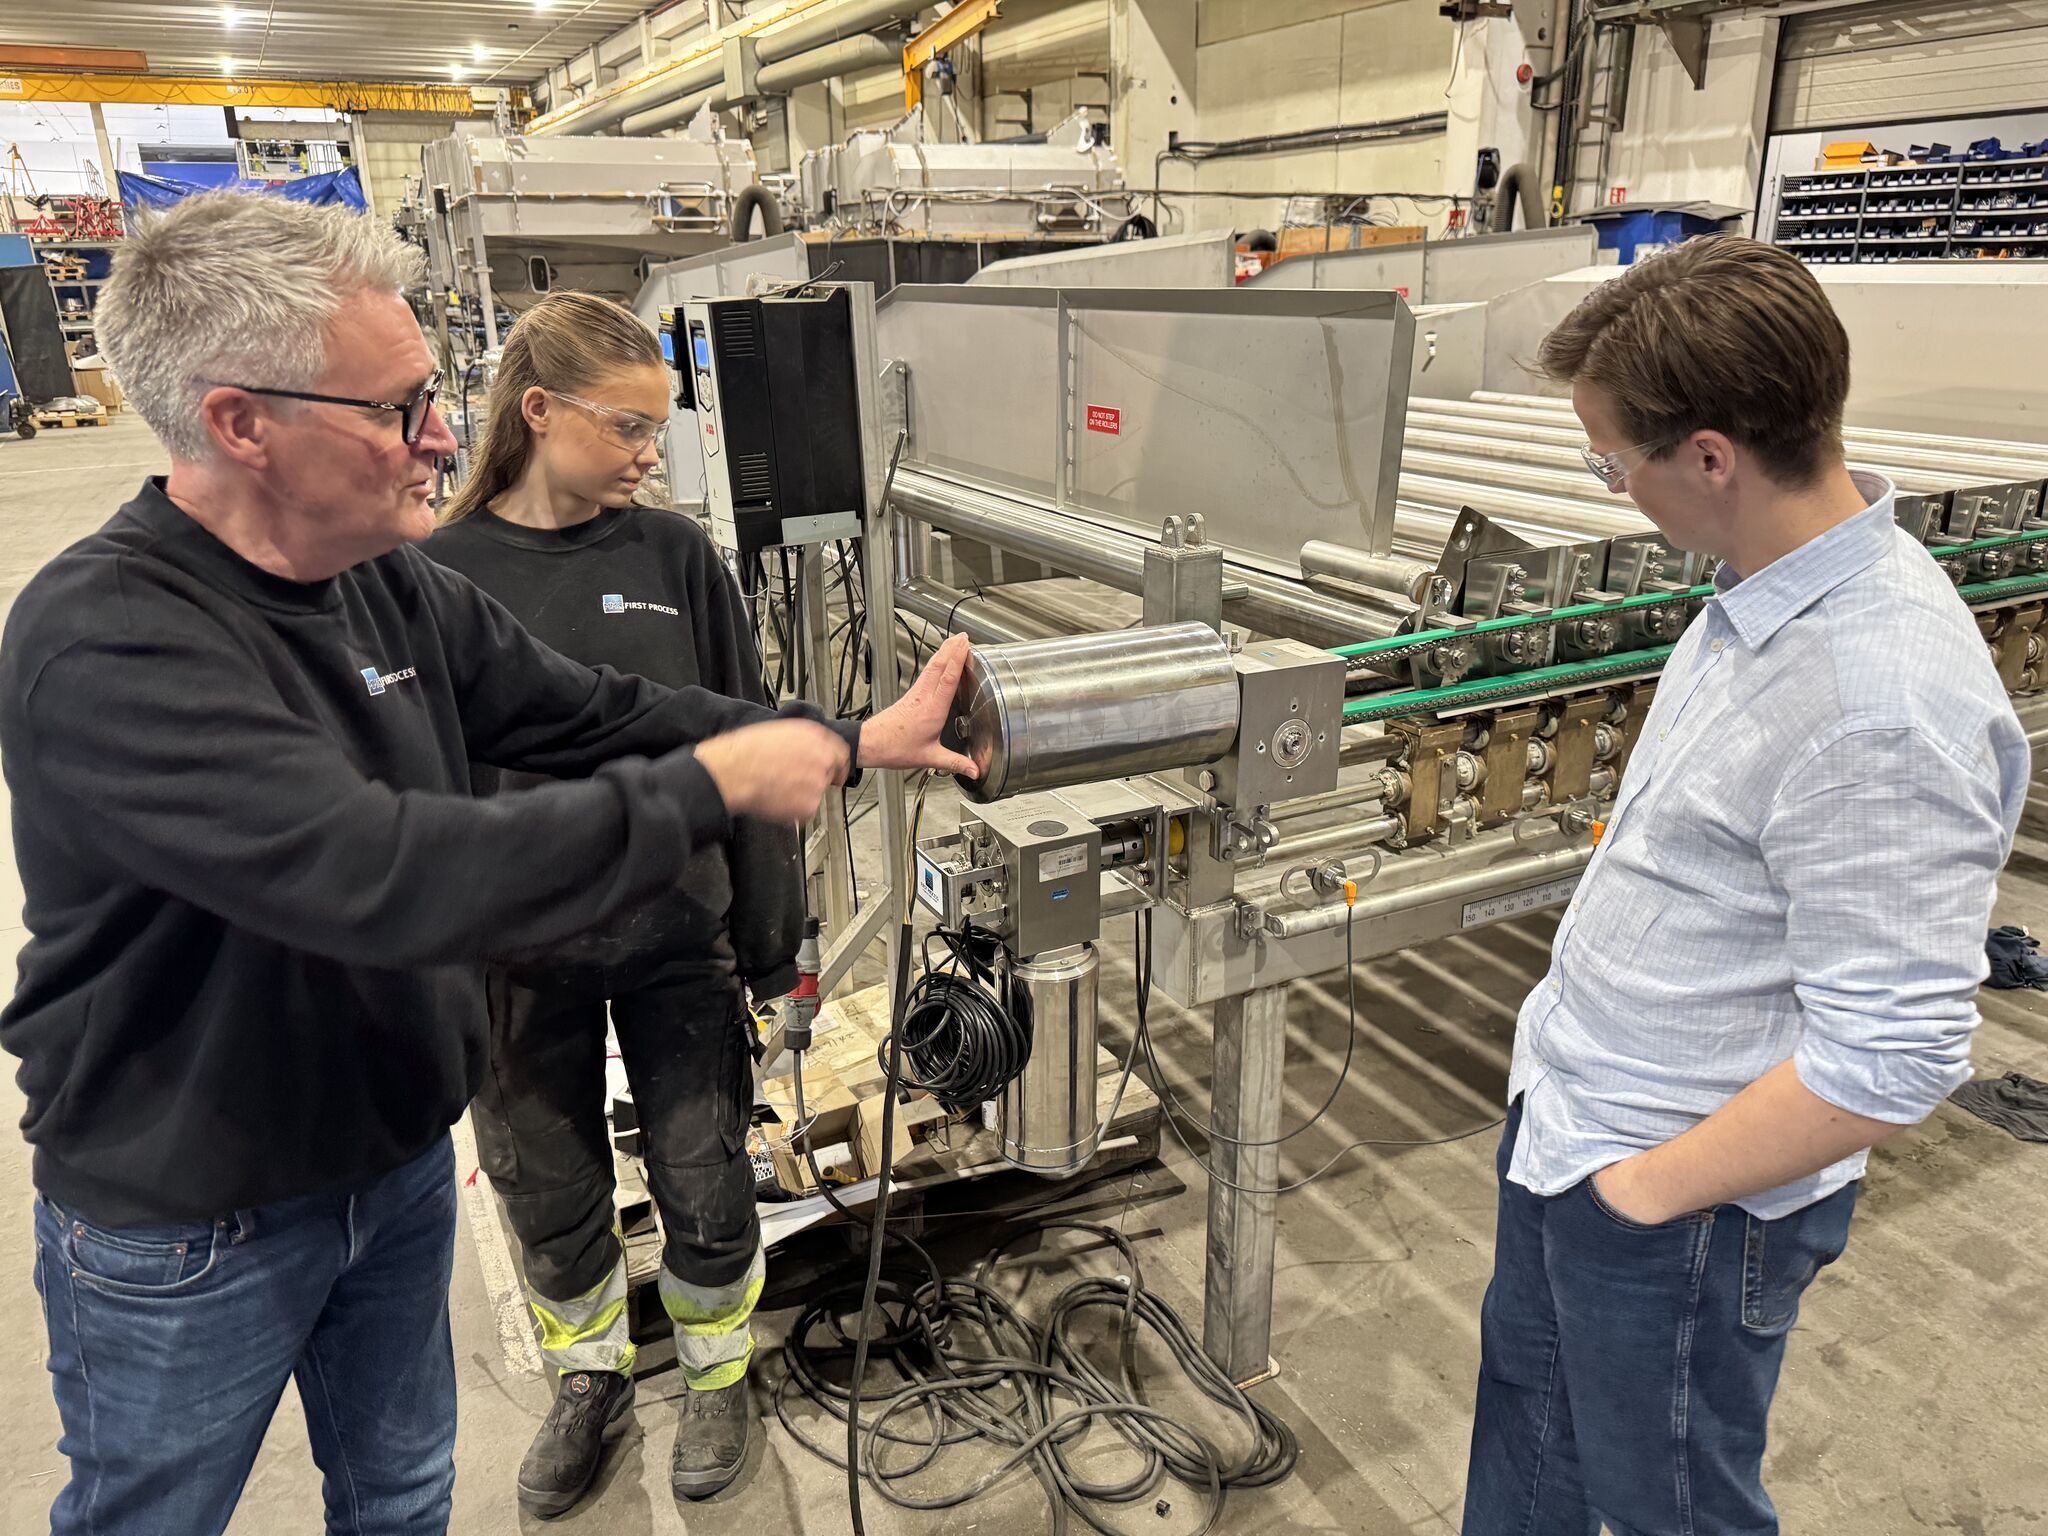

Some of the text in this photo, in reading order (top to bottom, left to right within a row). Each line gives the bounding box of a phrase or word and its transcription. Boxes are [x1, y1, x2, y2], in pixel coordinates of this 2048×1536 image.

[625, 602, 647, 610] FIRST
[648, 603, 679, 616] PROCESS
[1465, 914, 1476, 922] 150
[1484, 908, 1495, 917] 140
[1504, 903, 1515, 912] 130
[1523, 898, 1533, 907] 120
[1543, 893, 1552, 901] 110
